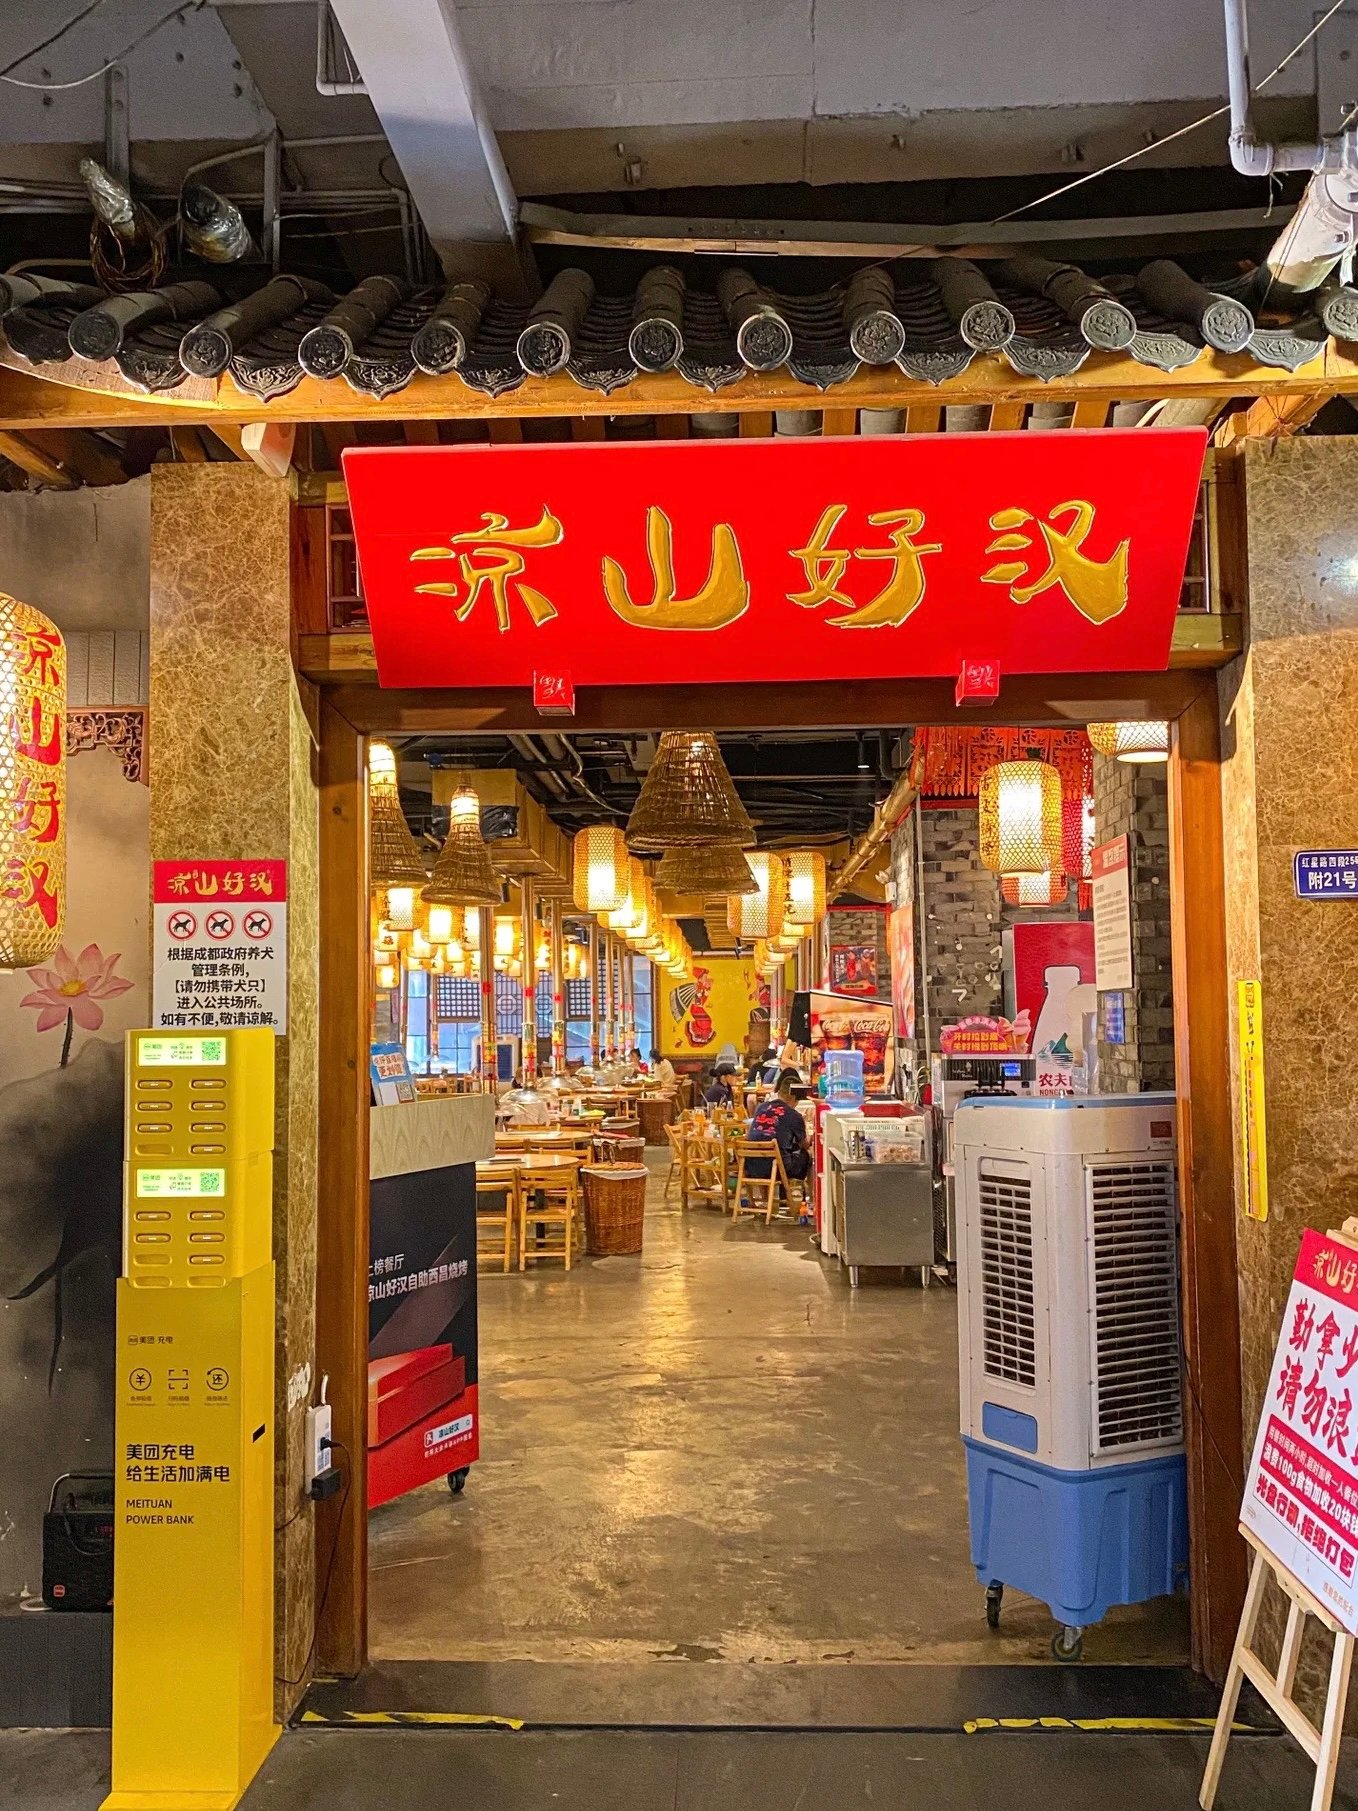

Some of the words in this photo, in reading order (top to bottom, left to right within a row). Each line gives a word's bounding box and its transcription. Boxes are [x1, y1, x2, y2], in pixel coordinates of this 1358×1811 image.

[409, 500, 1130, 632] 凉山好汉
[2, 624, 62, 929] 凉山好汉
[168, 869, 273, 896] 凉山好汉
[1308, 871, 1358, 890] 附21号
[167, 947, 274, 961] 根据成都政府养犬
[175, 979, 266, 993] 【请勿携带犬只】
[176, 995, 263, 1009] 进入公共场所。
[1038, 1073, 1073, 1087] 农夫
[1313, 1249, 1358, 1294] 凉山好
[1276, 1355, 1358, 1467] 请勿浪
[126, 1444, 195, 1460] 美团充电
[126, 1465, 230, 1482] 给生活加满电
[126, 1499, 173, 1509] MEITUAN
[126, 1515, 164, 1525] POWER
[166, 1515, 195, 1525] BANK
